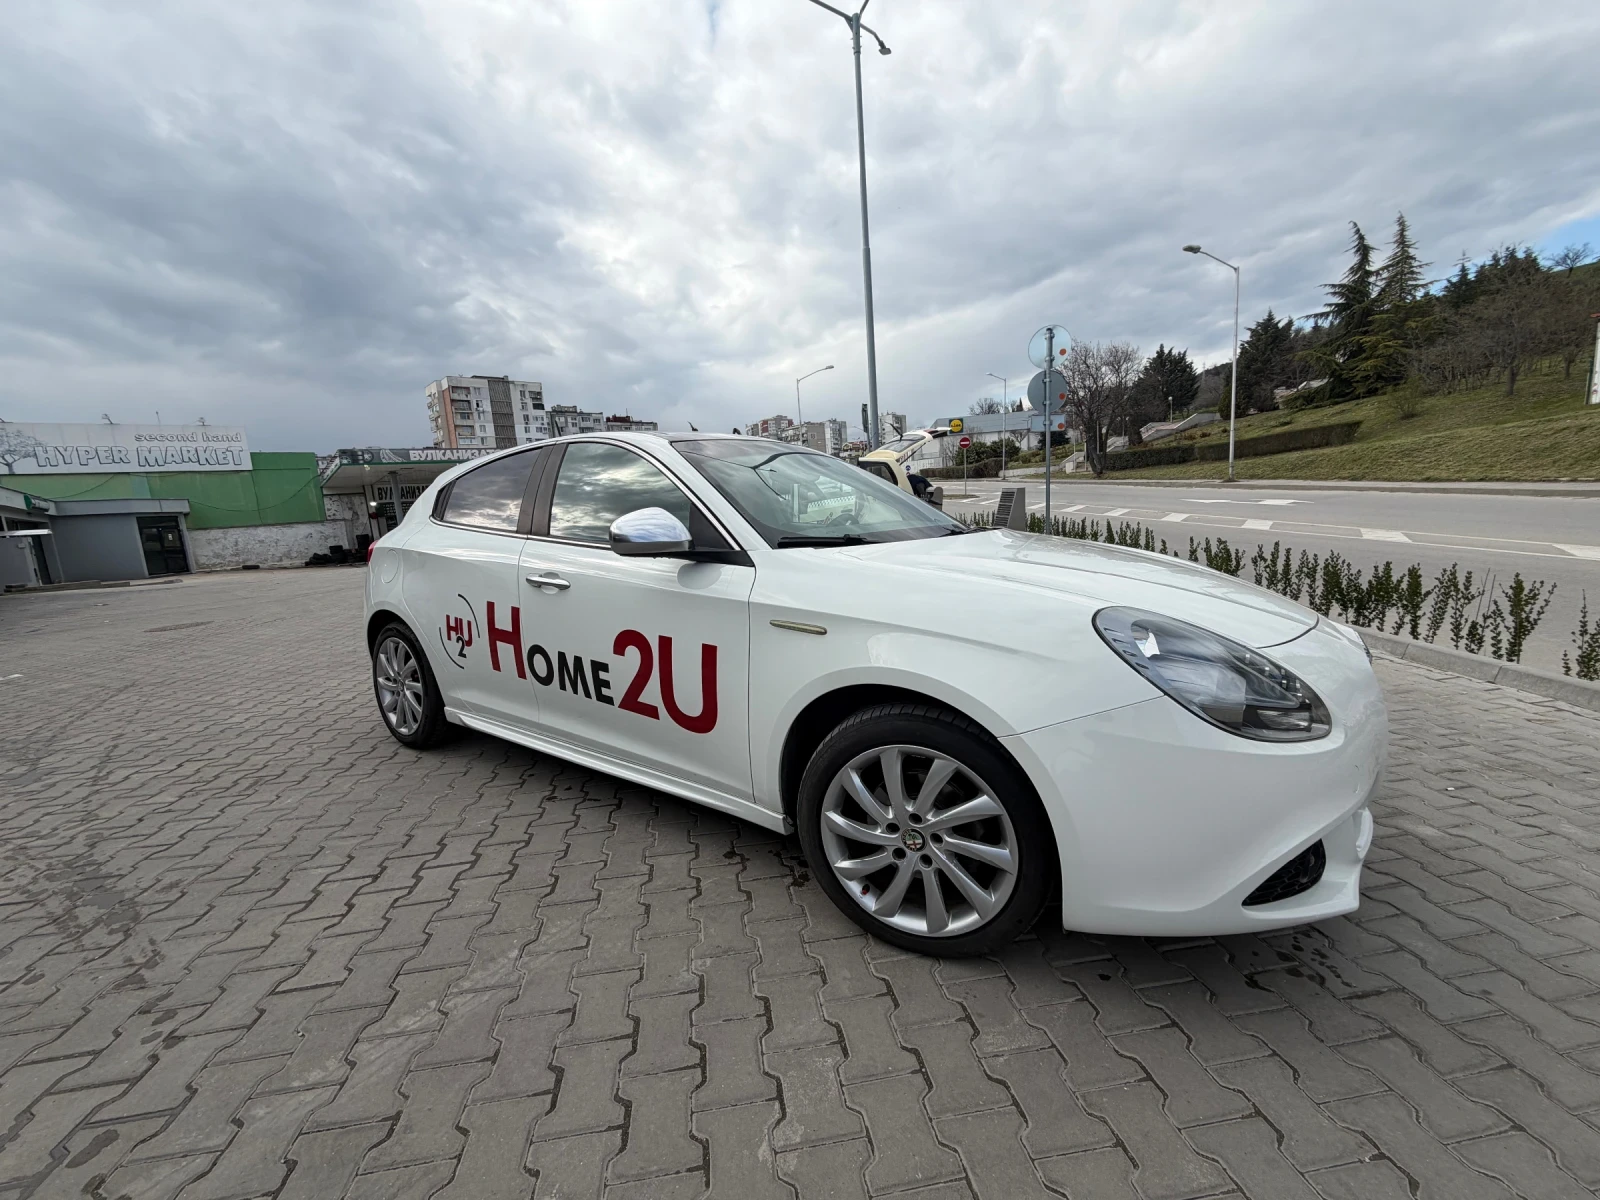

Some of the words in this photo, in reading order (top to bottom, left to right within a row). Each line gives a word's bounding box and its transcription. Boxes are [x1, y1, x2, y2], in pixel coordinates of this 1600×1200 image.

[134, 431, 198, 443] second
[201, 431, 242, 443] hand
[34, 446, 131, 467] HYPER
[136, 446, 244, 467] MARKET
[409, 449, 499, 461] ВУЛКАНИЗАТ
